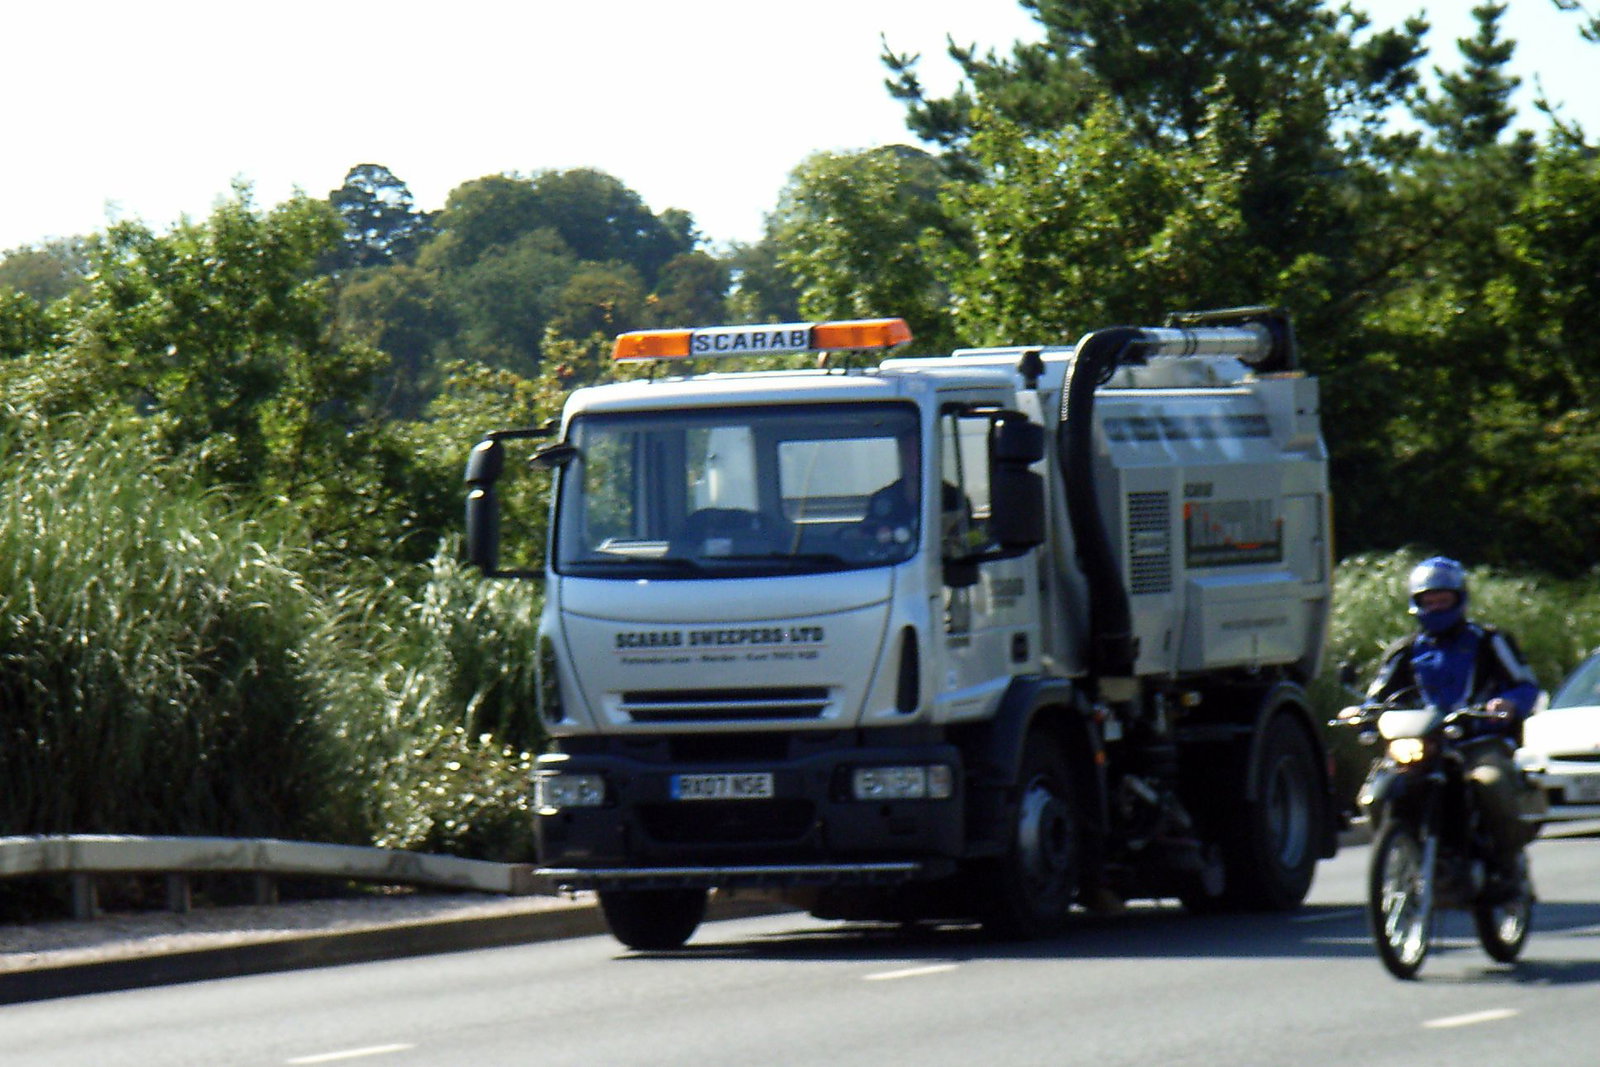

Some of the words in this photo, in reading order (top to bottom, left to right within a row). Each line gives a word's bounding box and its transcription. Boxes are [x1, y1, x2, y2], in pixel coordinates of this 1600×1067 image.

[694, 330, 808, 351] SCARAB
[615, 631, 682, 648] SCARAB
[688, 627, 784, 646] SWEEPERS
